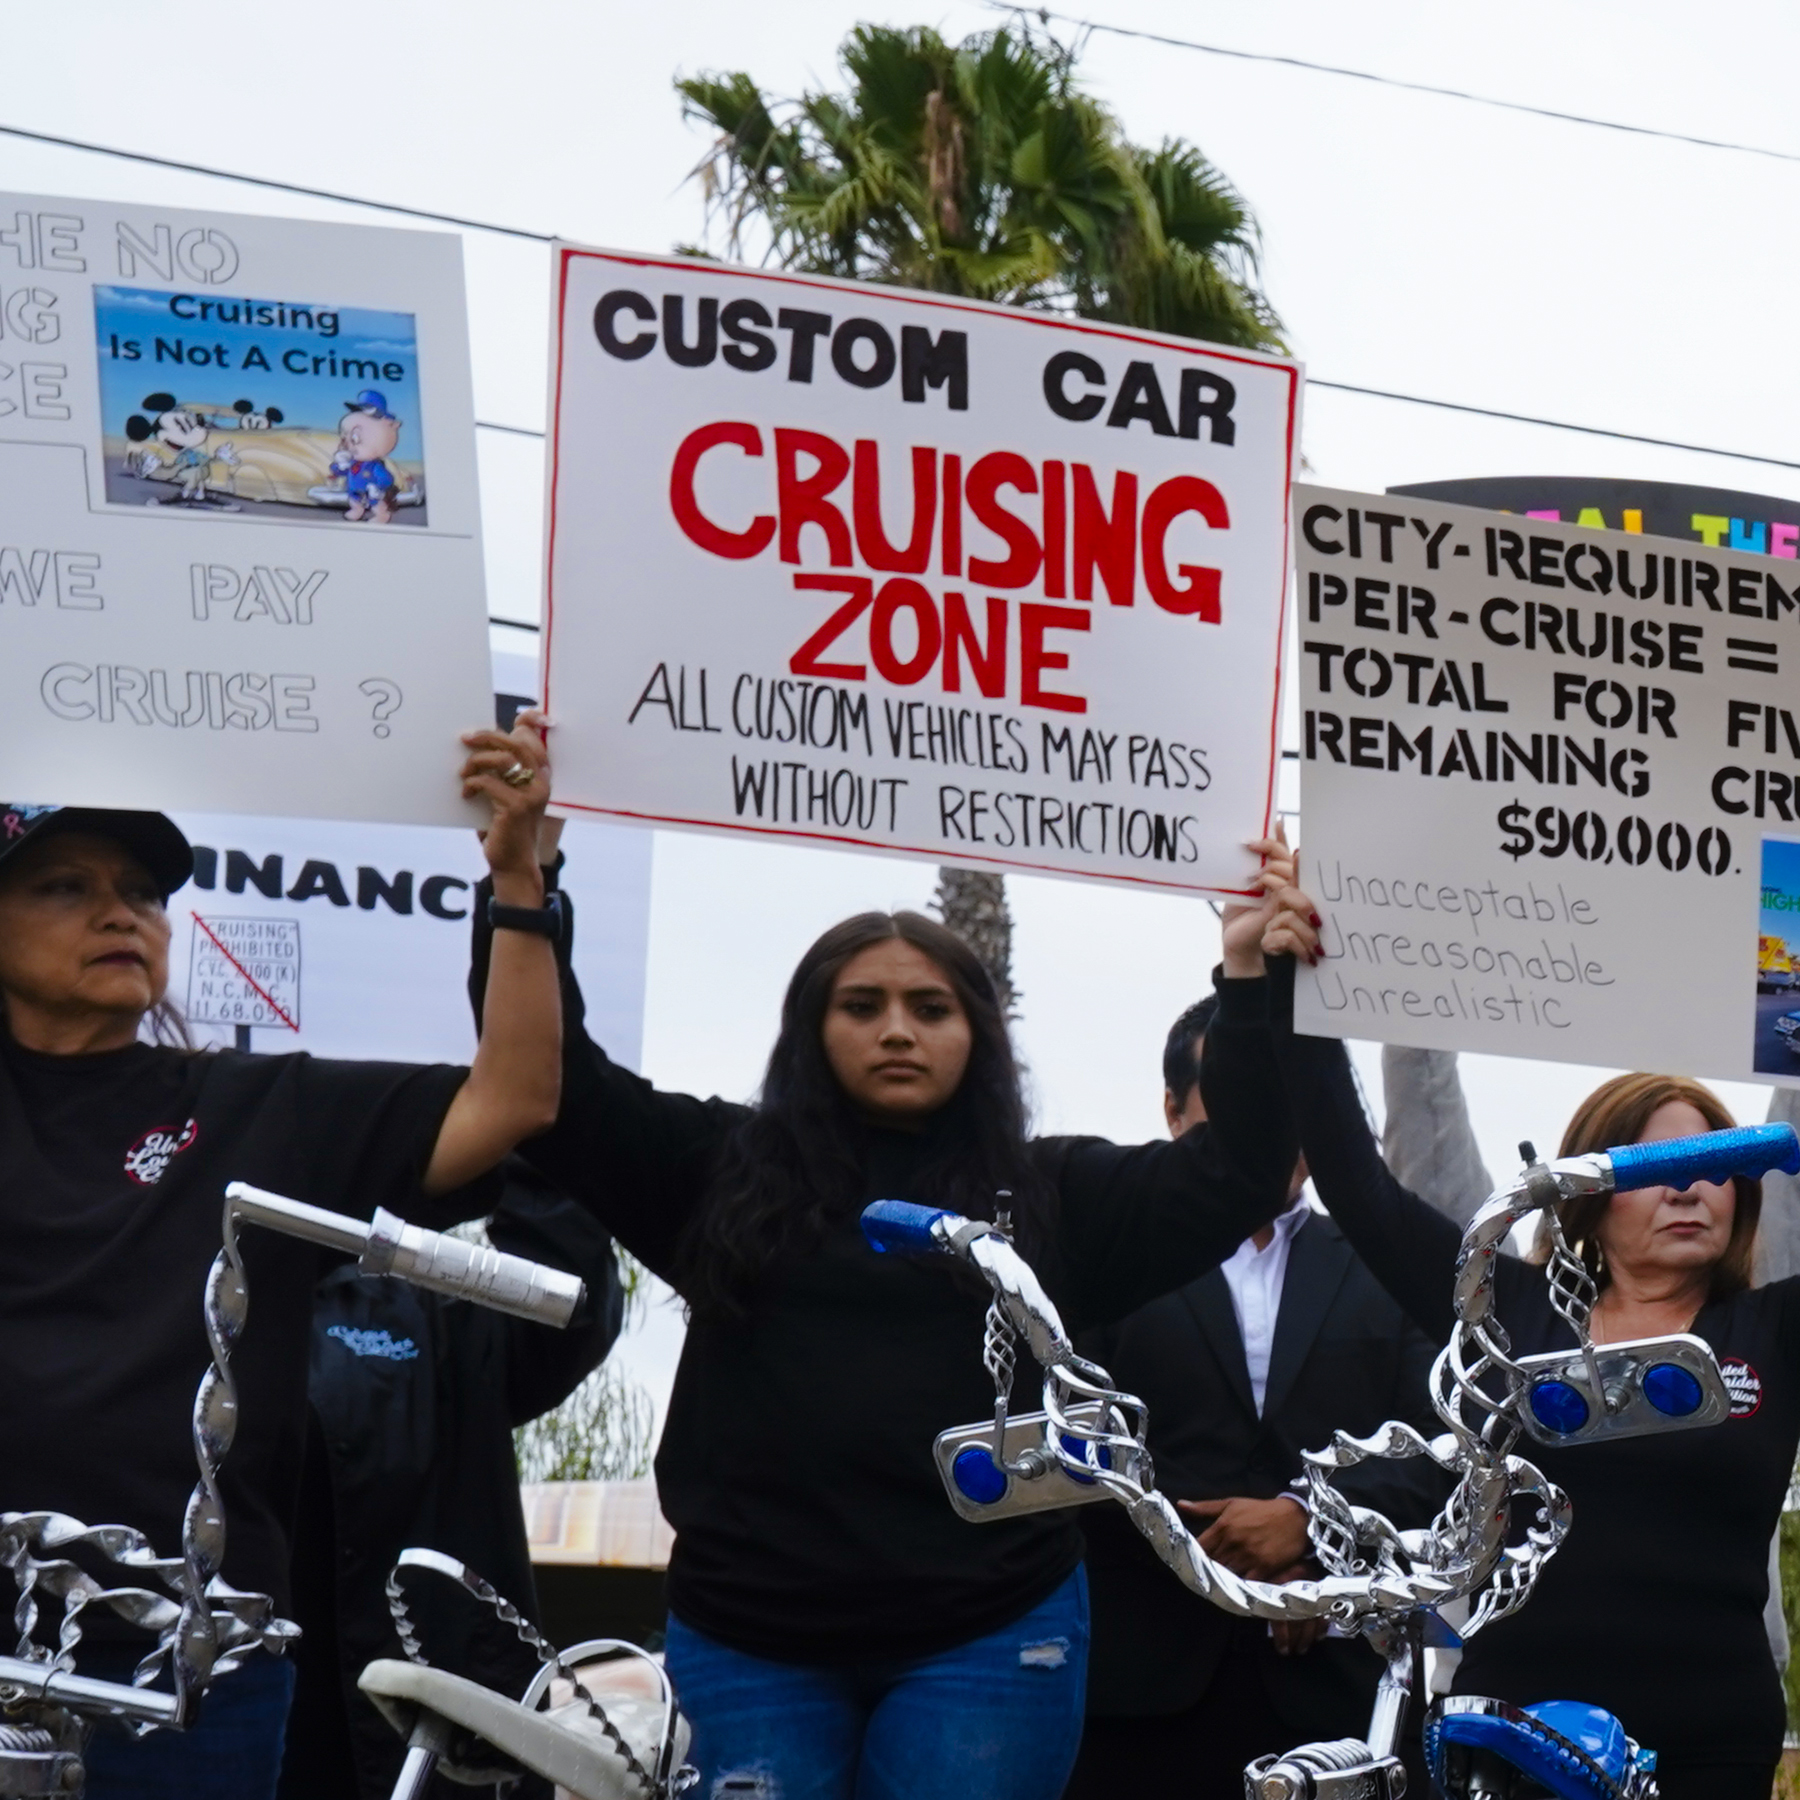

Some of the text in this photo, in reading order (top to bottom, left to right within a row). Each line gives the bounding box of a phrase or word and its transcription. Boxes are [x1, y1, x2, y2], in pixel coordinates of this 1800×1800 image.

[116, 220, 240, 285] NO
[168, 293, 340, 338] Cruising
[110, 333, 405, 383] Is Not A Crime
[593, 288, 1239, 447] CUSTOM CAR
[668, 420, 1232, 626] CRUISING
[189, 562, 330, 626] PAY
[788, 572, 1092, 715] ZONE
[40, 661, 404, 740] CRUISE ?
[627, 661, 1212, 793] ALL CUSTOM VEHICLES MAY PASS
[1302, 639, 1511, 714] TOTAL
[1551, 671, 1679, 740] FOR
[1302, 708, 1651, 800] REMAINING
[730, 754, 1200, 865] WITHOUT RESTRICTIONS
[1496, 797, 1743, 878] $90,000.
[1317, 858, 1601, 929] Unacceptable
[1317, 921, 1616, 989] Unreasonable
[1314, 974, 1572, 1031] Unrealistic
